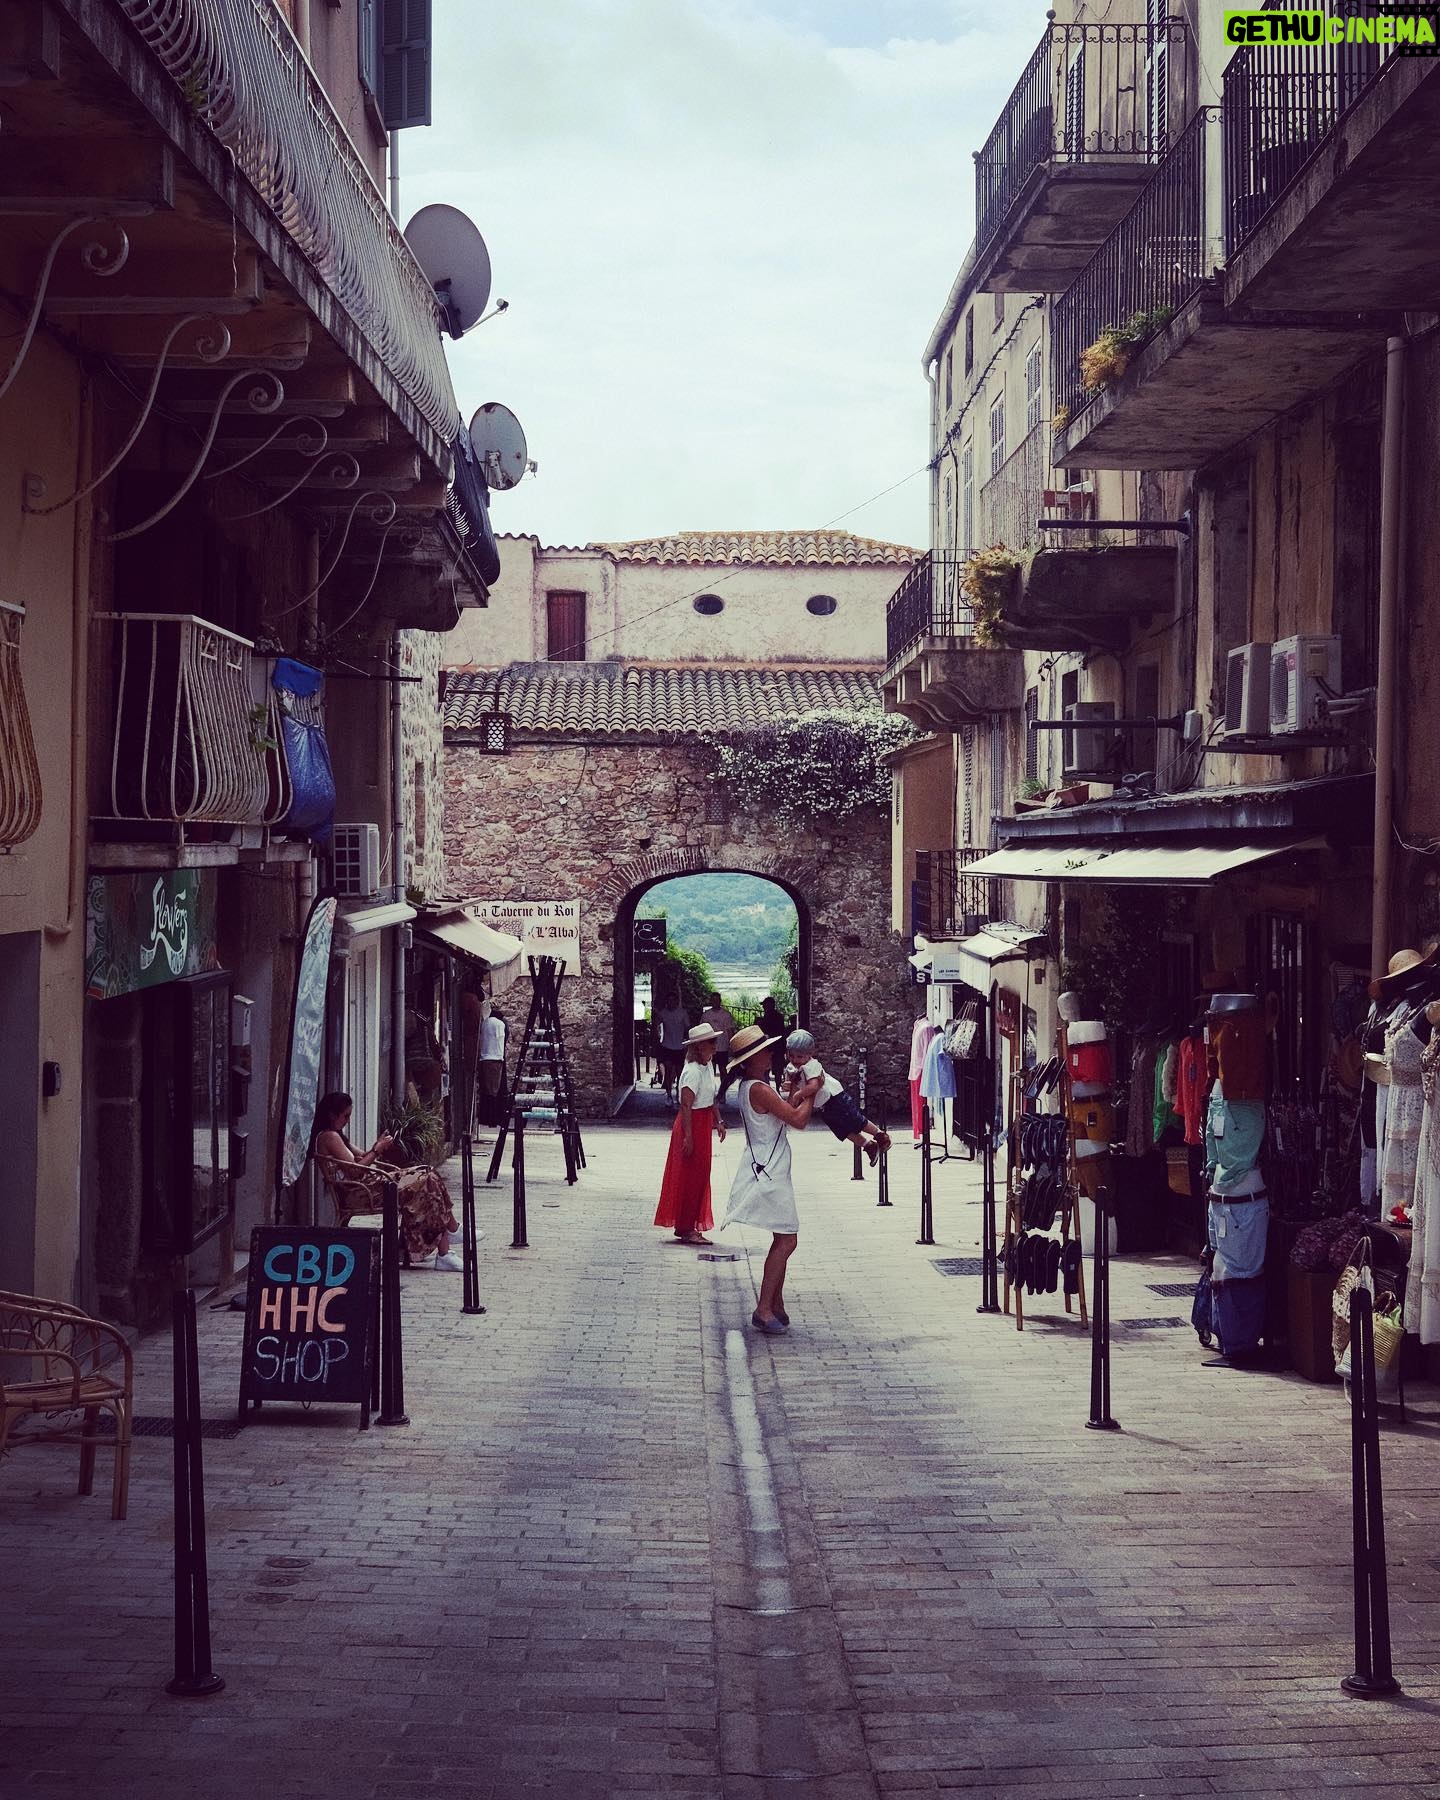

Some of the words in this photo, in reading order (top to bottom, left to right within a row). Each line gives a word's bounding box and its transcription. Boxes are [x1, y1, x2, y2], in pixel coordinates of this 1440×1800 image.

[150, 876, 188, 948] Flowers
[473, 905, 487, 917] La
[491, 905, 534, 917] Taverne
[537, 905, 550, 917] du
[554, 904, 574, 917] Roi
[531, 925, 579, 940] (L'Alba)
[264, 1244, 356, 1287] CBD
[259, 1286, 349, 1333] HHC
[253, 1335, 350, 1384] SHOP
